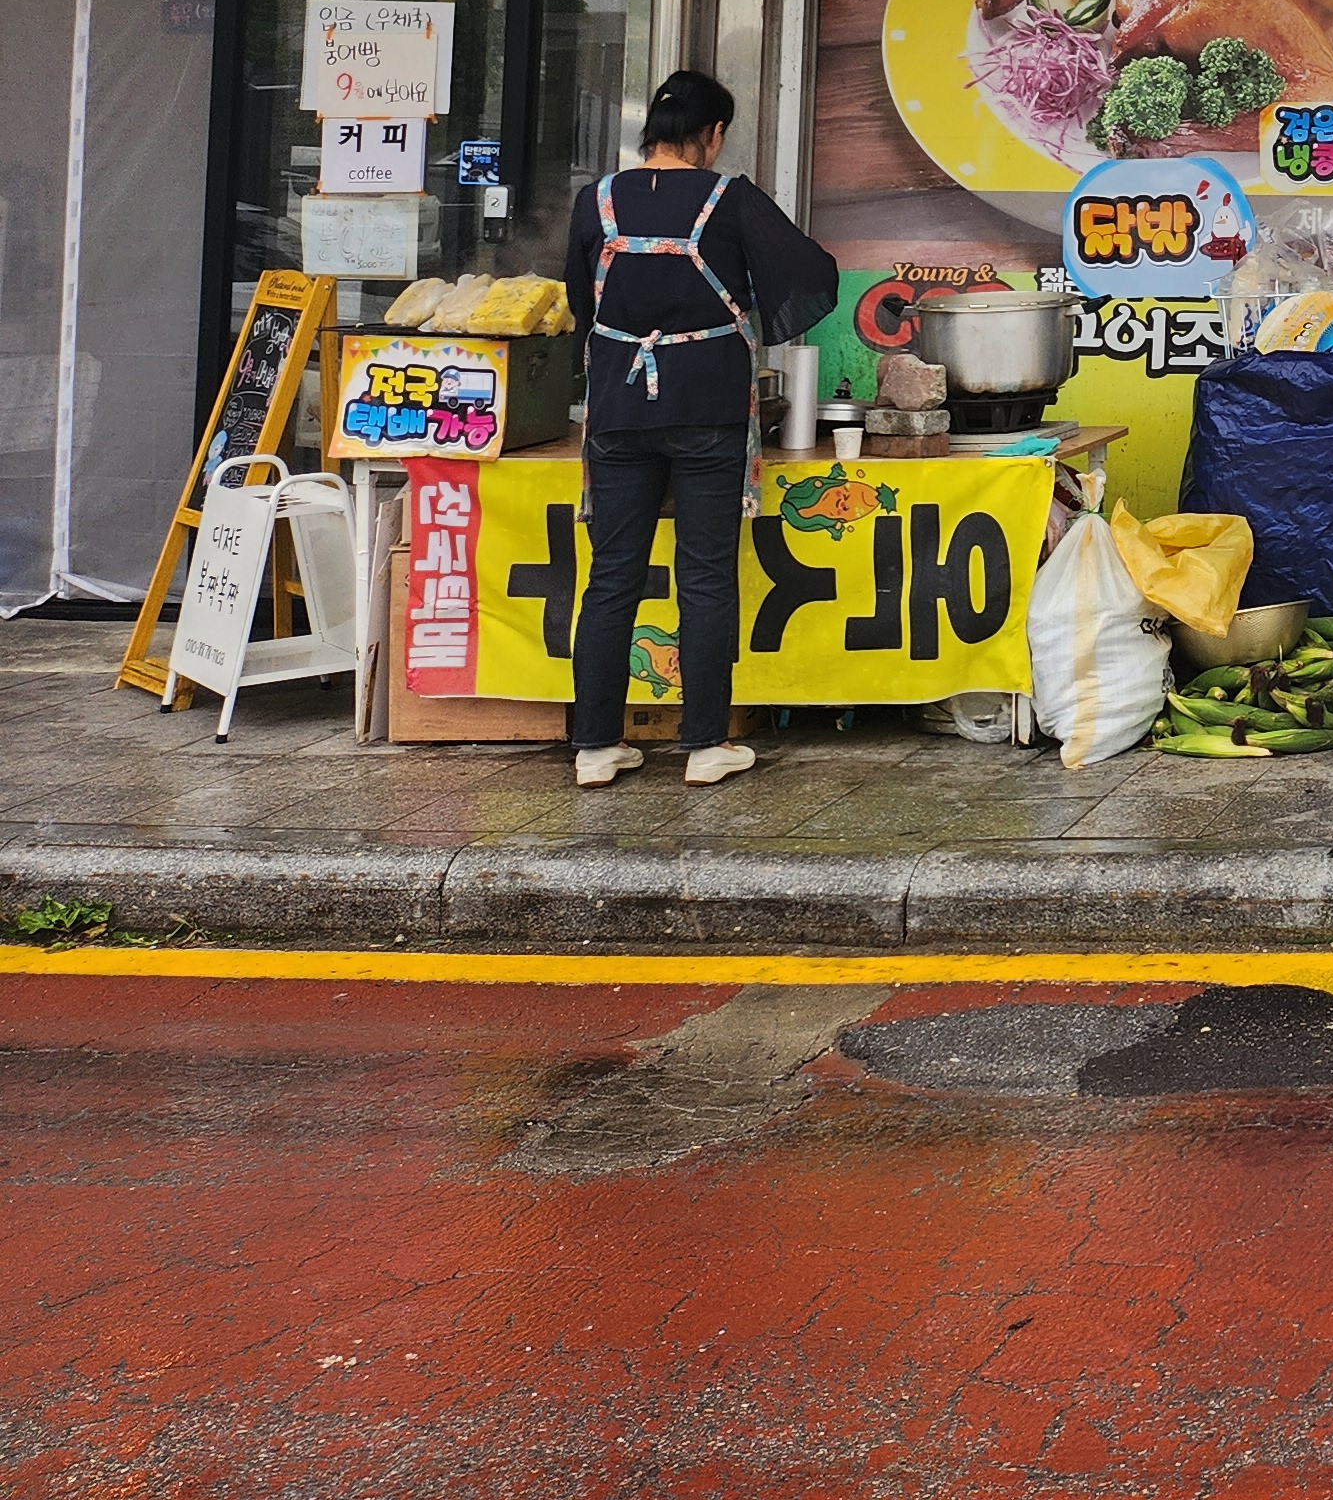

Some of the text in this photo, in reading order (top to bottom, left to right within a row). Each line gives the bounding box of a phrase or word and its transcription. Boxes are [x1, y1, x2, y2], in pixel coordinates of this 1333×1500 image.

[319, 6, 357, 32] 입금
[324, 38, 382, 67] 붕어빵
[348, 165, 393, 180] coffee
[1079, 200, 1195, 259] 닭발
[892, 262, 998, 286] Young &
[368, 366, 440, 408] 전국
[212, 523, 243, 556] 디저트
[408, 480, 472, 670] 전국택배
